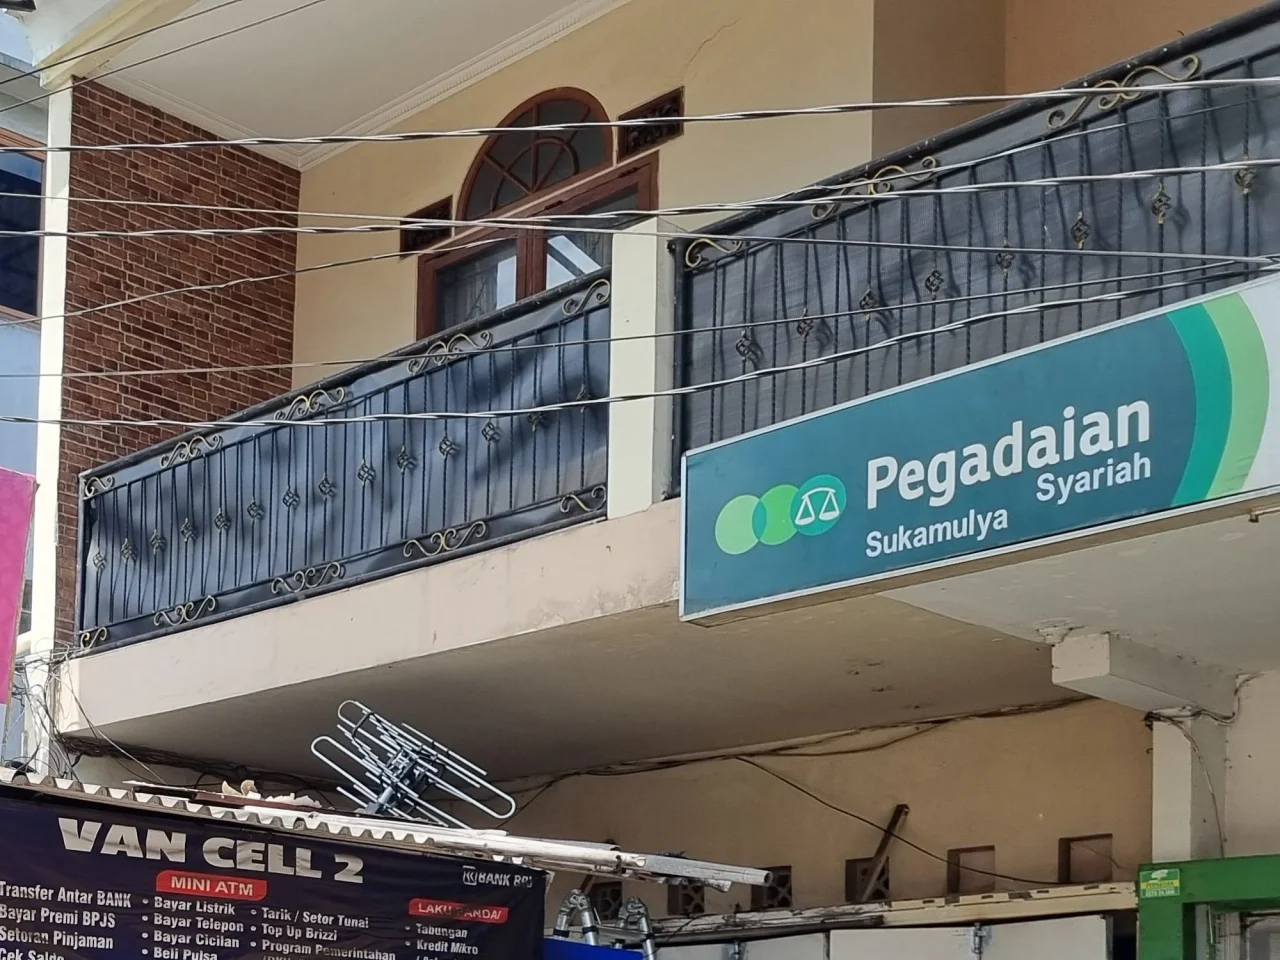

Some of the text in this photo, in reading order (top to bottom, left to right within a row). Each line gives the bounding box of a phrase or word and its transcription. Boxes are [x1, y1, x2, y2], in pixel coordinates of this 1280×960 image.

[866, 399, 1151, 511] Pegadaian
[1037, 453, 1152, 506] Syariah
[866, 508, 1009, 559] Sukamulya
[58, 817, 365, 884] VAN CELL 2
[171, 876, 253, 896] MINI ATM
[478, 873, 510, 887] BANK
[57, 887, 93, 904] Antar
[97, 890, 132, 908] BANK
[154, 896, 236, 915] Bayar Listrik
[40, 907, 78, 925] Premi
[82, 911, 116, 928] BPJS
[154, 912, 244, 933] Bayar Telepon
[261, 907, 292, 921] Tarik
[302, 911, 335, 925] Setor
[338, 915, 369, 929] Tunai
[53, 930, 114, 950] Pinjaman
[154, 930, 240, 948] Bayar Cicilan
[261, 923, 338, 942] Top Up Brizzi
[416, 923, 468, 939] Tabungan
[153, 947, 178, 960] Beli
[261, 939, 312, 955] Program
[417, 940, 479, 955] Kredit Mikro
